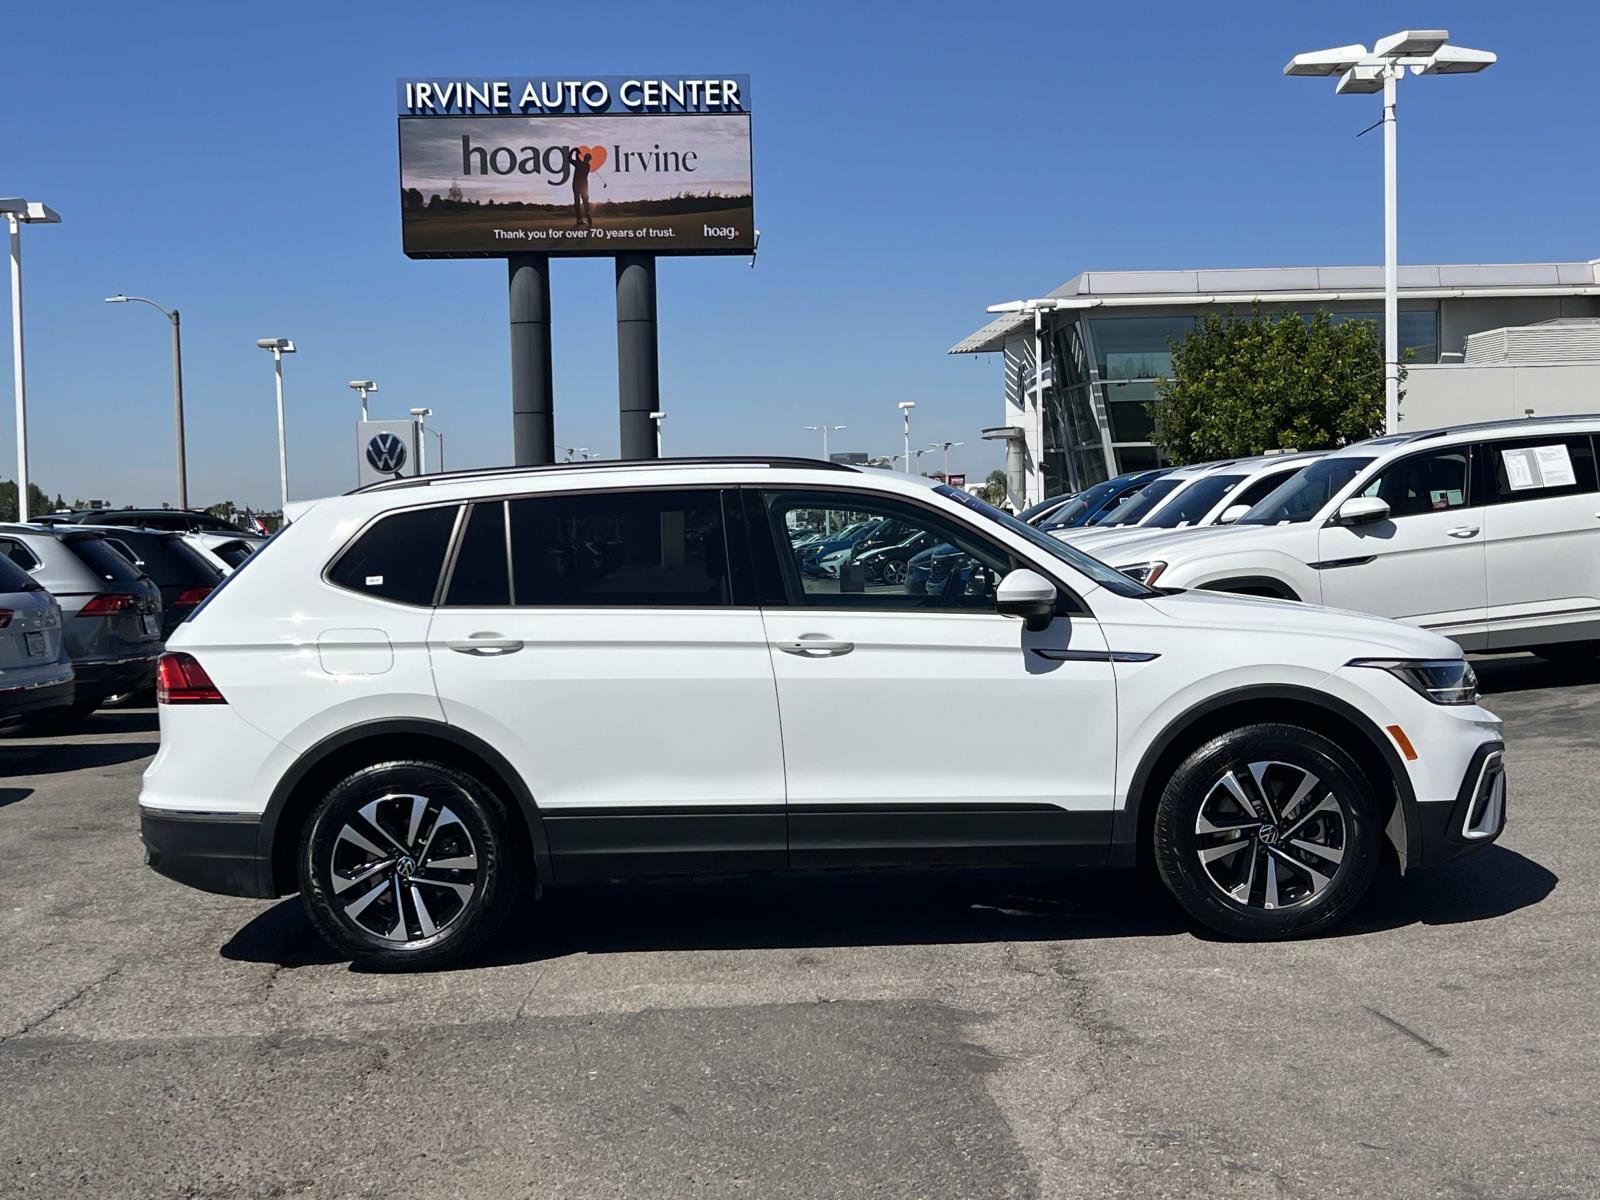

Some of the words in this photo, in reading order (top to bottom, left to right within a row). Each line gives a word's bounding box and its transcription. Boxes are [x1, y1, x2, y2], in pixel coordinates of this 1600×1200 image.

[406, 82, 508, 109] IRVINE
[519, 81, 608, 108] AUTO
[620, 80, 740, 106] CENTER
[462, 134, 571, 186] hoag
[613, 144, 698, 173] Irvine
[493, 229, 526, 239] Thank
[527, 231, 546, 240] you
[549, 229, 564, 239] for
[590, 228, 604, 238] 70
[606, 229, 634, 240] years
[636, 228, 647, 238] of
[649, 228, 676, 238] trust.
[367, 433, 406, 473] VW
